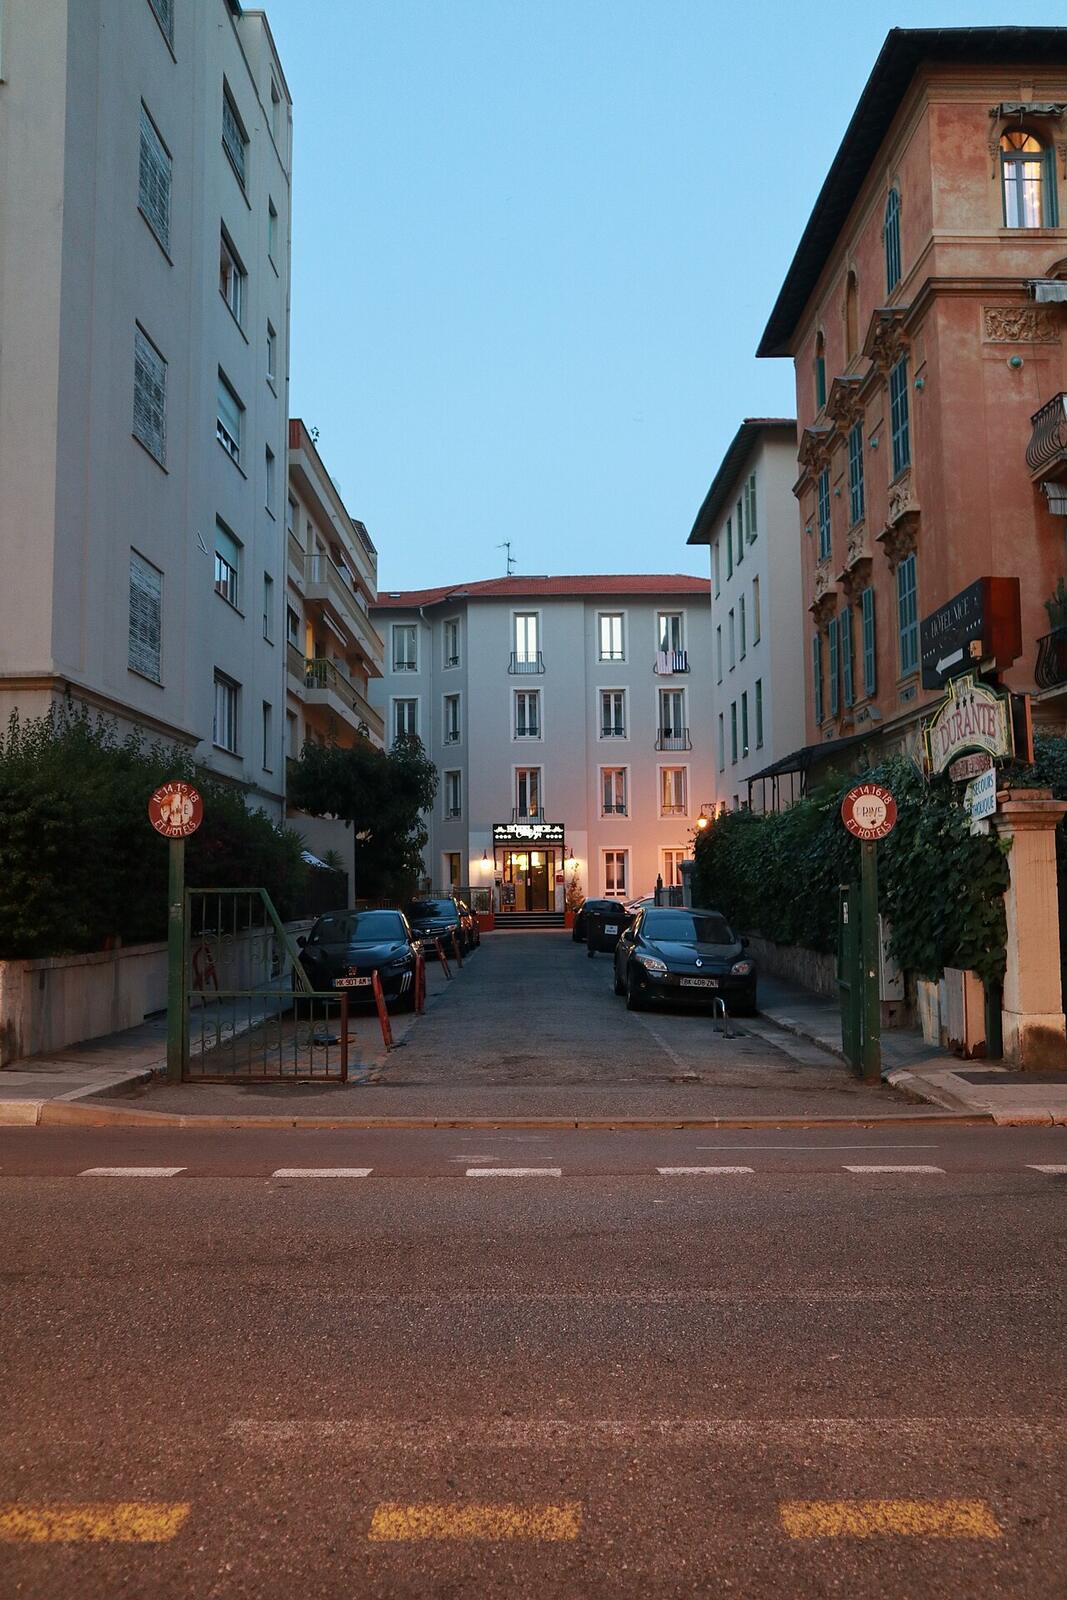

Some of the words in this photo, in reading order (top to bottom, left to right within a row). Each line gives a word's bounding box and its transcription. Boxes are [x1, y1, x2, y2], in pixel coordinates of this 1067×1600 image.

[940, 703, 996, 755] DURANTE
[973, 773, 994, 796] SECOURS
[154, 819, 166, 830] ET
[165, 820, 196, 836] HOTELS
[846, 818, 858, 831] ET
[857, 821, 891, 838] HOTELS
